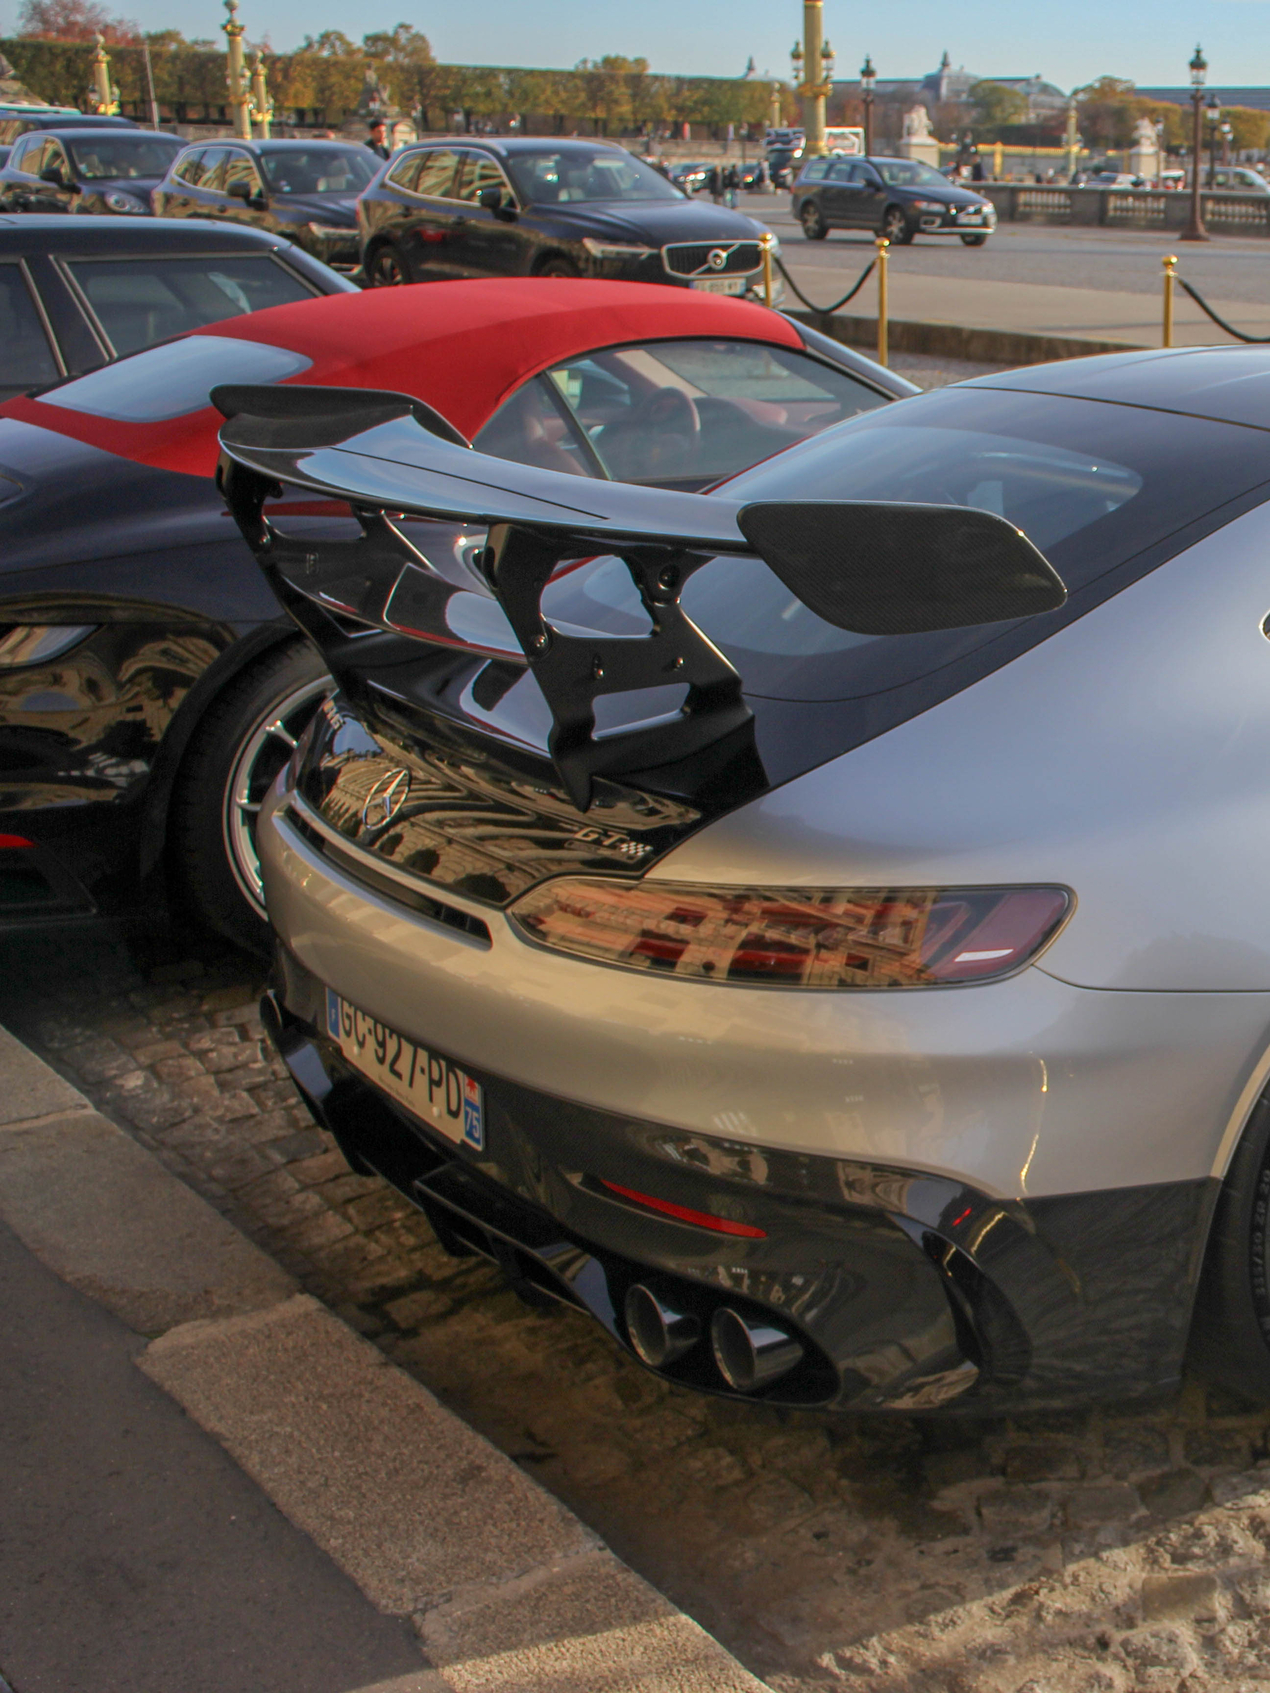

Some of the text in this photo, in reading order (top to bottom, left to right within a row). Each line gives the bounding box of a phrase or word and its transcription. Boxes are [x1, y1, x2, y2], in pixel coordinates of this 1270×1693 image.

[573, 827, 630, 847] GT
[340, 998, 462, 1120] GC-927-PD
[465, 1106, 480, 1139] 75
